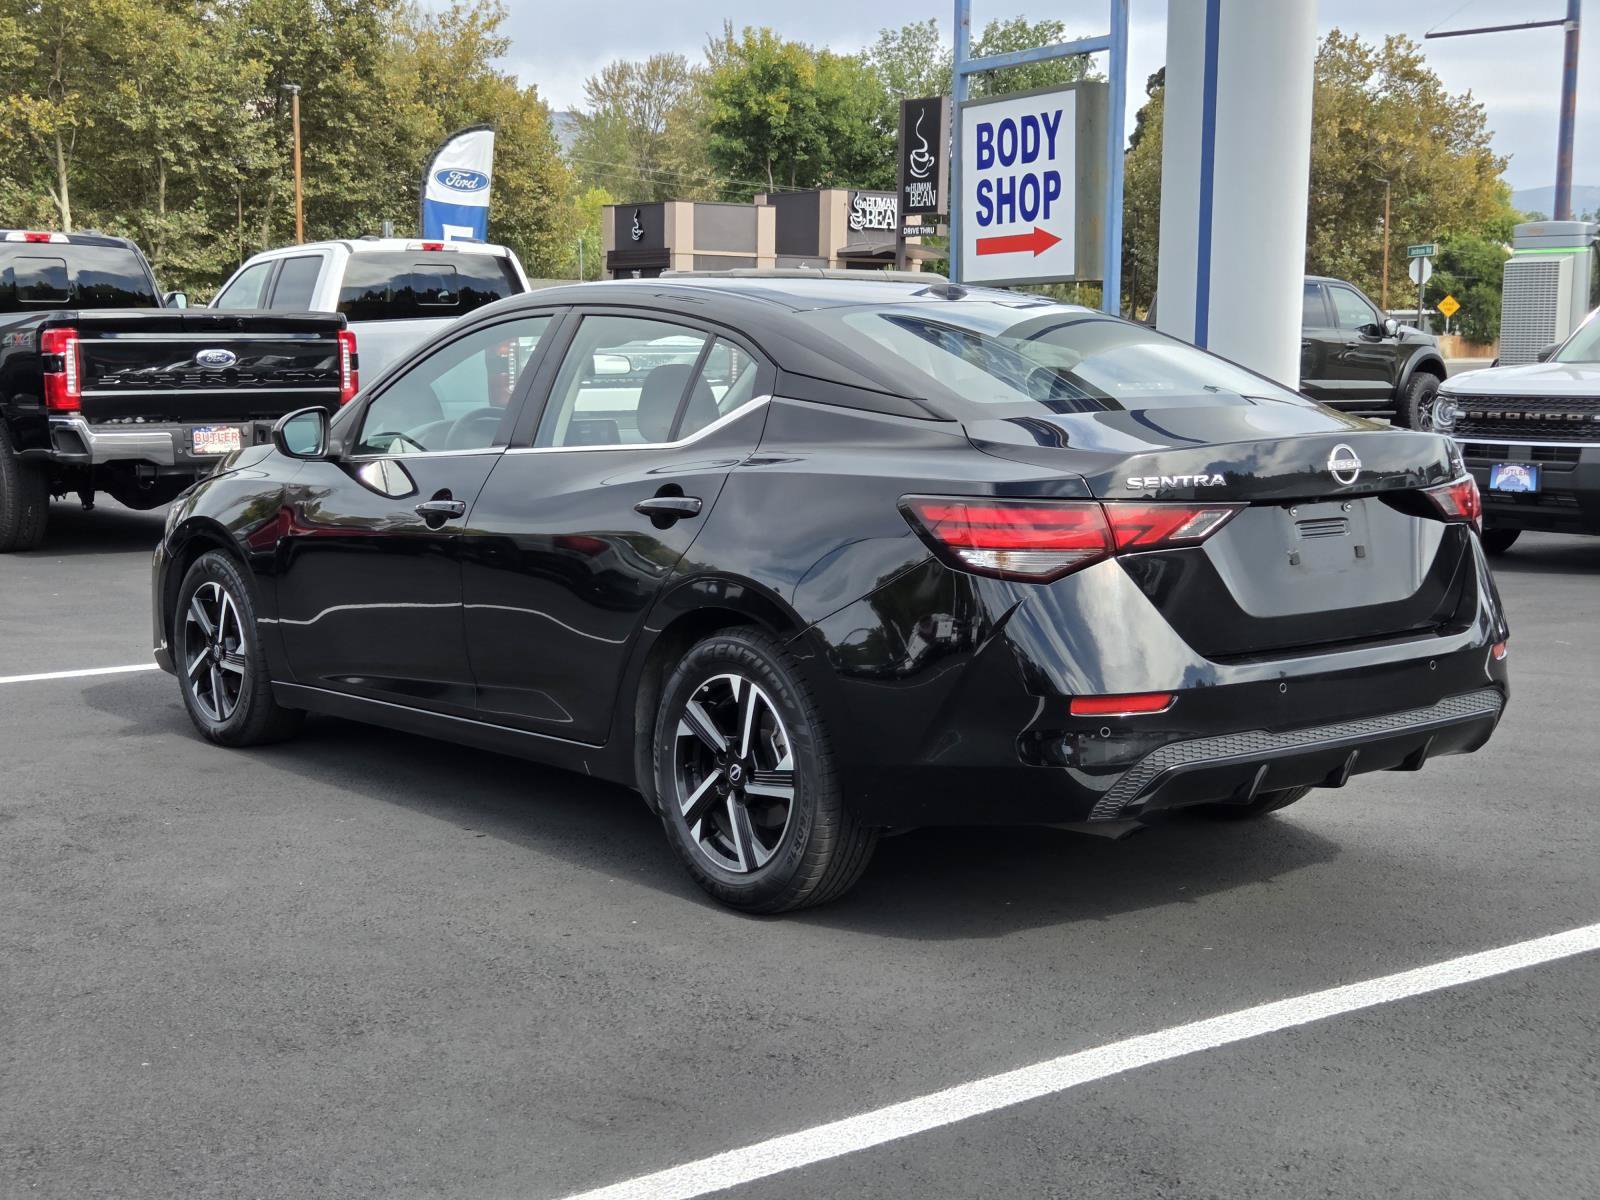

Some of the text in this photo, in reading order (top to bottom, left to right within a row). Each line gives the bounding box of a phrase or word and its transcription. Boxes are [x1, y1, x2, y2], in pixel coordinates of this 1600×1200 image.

[976, 109, 1063, 170] BODY
[445, 170, 479, 189] Ford
[910, 182, 932, 193] HUMAN
[910, 190, 936, 207] BEAN
[976, 170, 1061, 227] SHOP
[864, 209, 897, 229] BEA
[903, 226, 935, 235] DRIVE THRU
[1469, 411, 1584, 421] BRONCO
[194, 432, 238, 443] BUTLER
[1327, 458, 1362, 470] NISSAN
[1498, 468, 1529, 476] BUTLER
[1126, 474, 1227, 490] SENTRA
